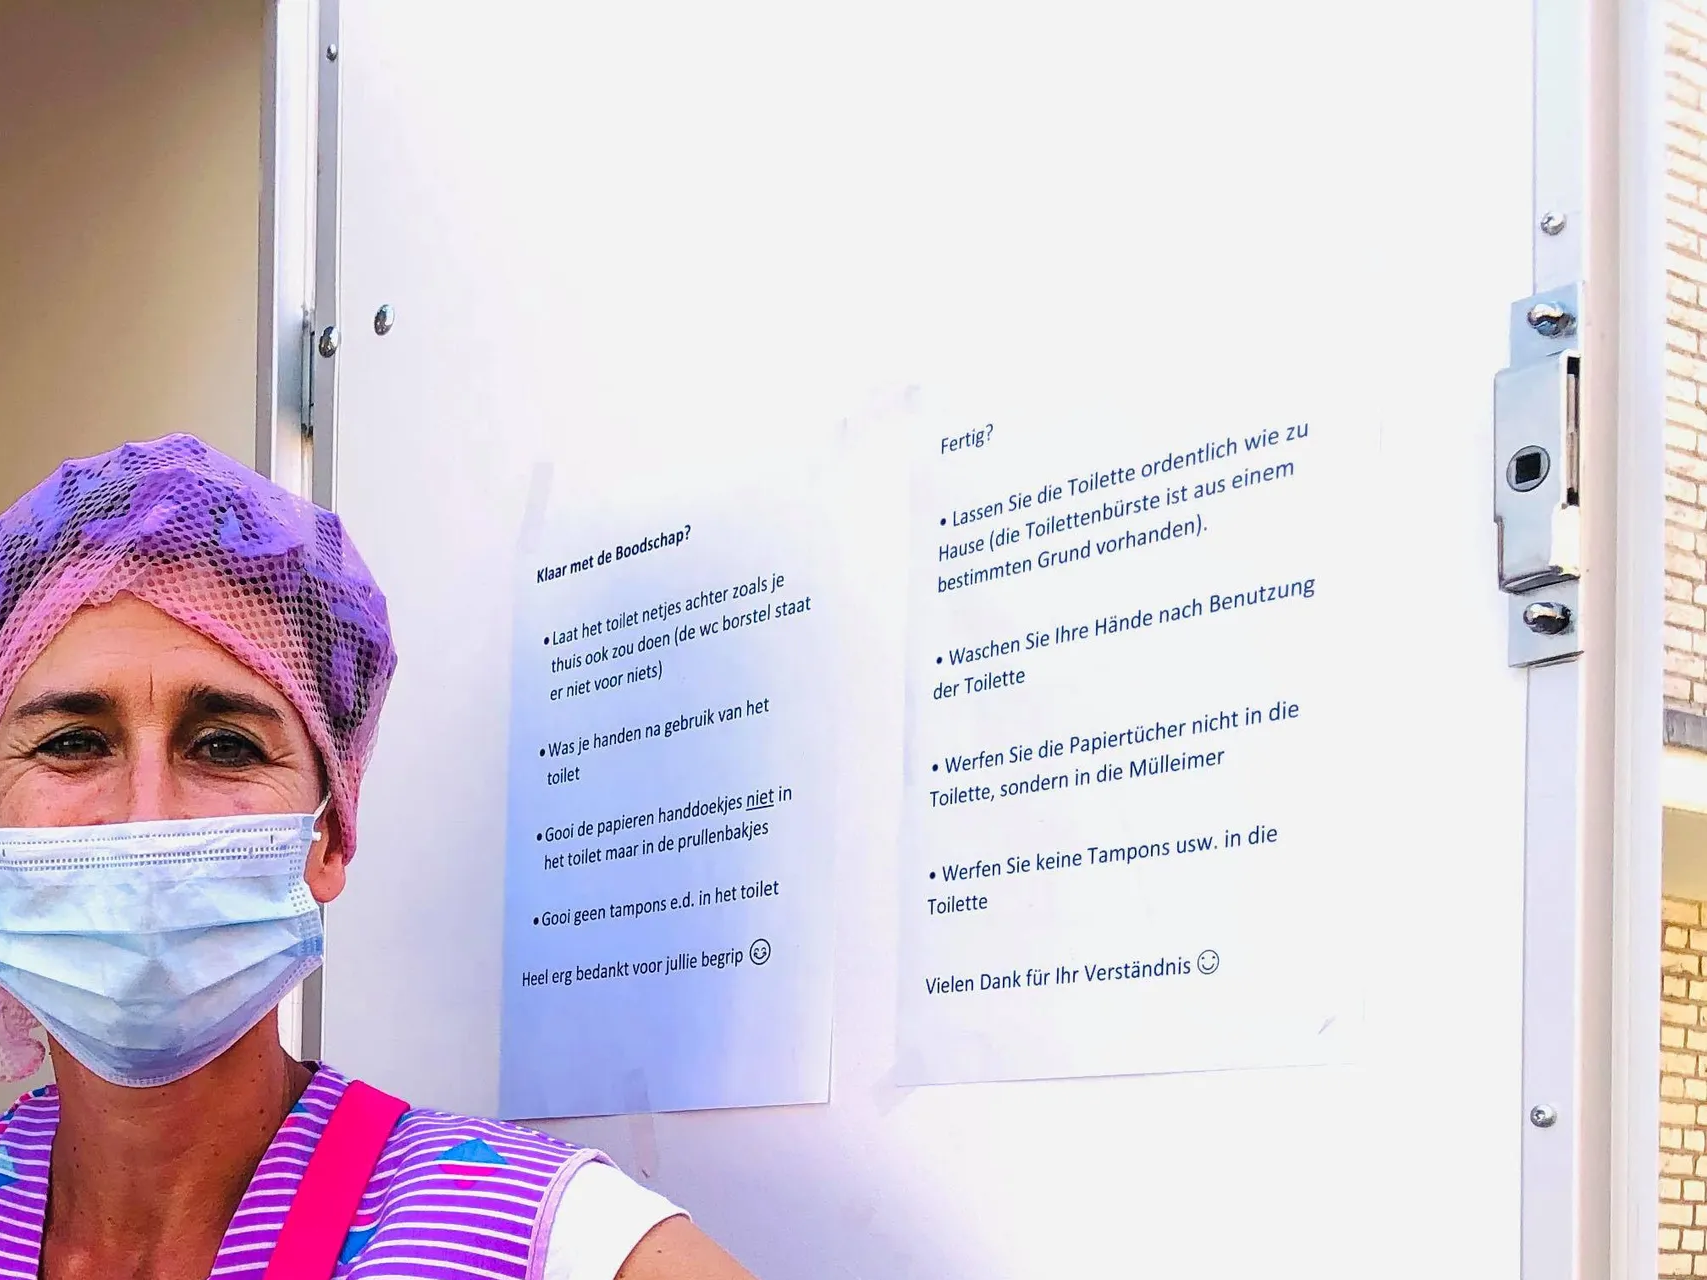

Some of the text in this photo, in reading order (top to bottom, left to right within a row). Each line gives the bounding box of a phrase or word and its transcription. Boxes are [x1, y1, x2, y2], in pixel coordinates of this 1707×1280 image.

[941, 423, 994, 455] Fertig?
[952, 422, 1309, 528] Lassen Sie die Toilette ordentlich wie zu
[938, 461, 1294, 563] Hause (die Toilettenbürste ist aus einem
[536, 523, 692, 584] Klaar met de Boodschap?
[937, 513, 1208, 594] bestimmten Grund vorhanden).
[551, 596, 812, 674] thuis ook zou doen (de wc borstel staat
[552, 572, 785, 646] Laat het toilet netjes achter zoals je
[948, 578, 1316, 666] Waschen Sie Ihre Hände nach Benutzung
[549, 659, 663, 701] er niet voor niets)
[933, 669, 1026, 701] der Toilette
[547, 697, 770, 758] Was je handen na gebruik van het
[944, 700, 1300, 774] Werfen Sie die Papiertücher nicht in die
[546, 766, 581, 786] toilet
[929, 750, 1226, 808] Toilette, sondern in die Mülleimer
[544, 785, 792, 843] Gooi de papieren handdoekjes niet in
[544, 820, 769, 871] het toilet maar in de prullenbakjes
[941, 824, 1278, 883] Werfen Sie keine Tampons usw. in die
[541, 879, 780, 927] Gooi geen tampons e.d. in het toilet
[926, 894, 988, 916] Toilette
[522, 947, 744, 987] Heel erg bedankt voor jullie begrip
[925, 956, 1191, 995] Vielen Dank für Ihr Verständnis
